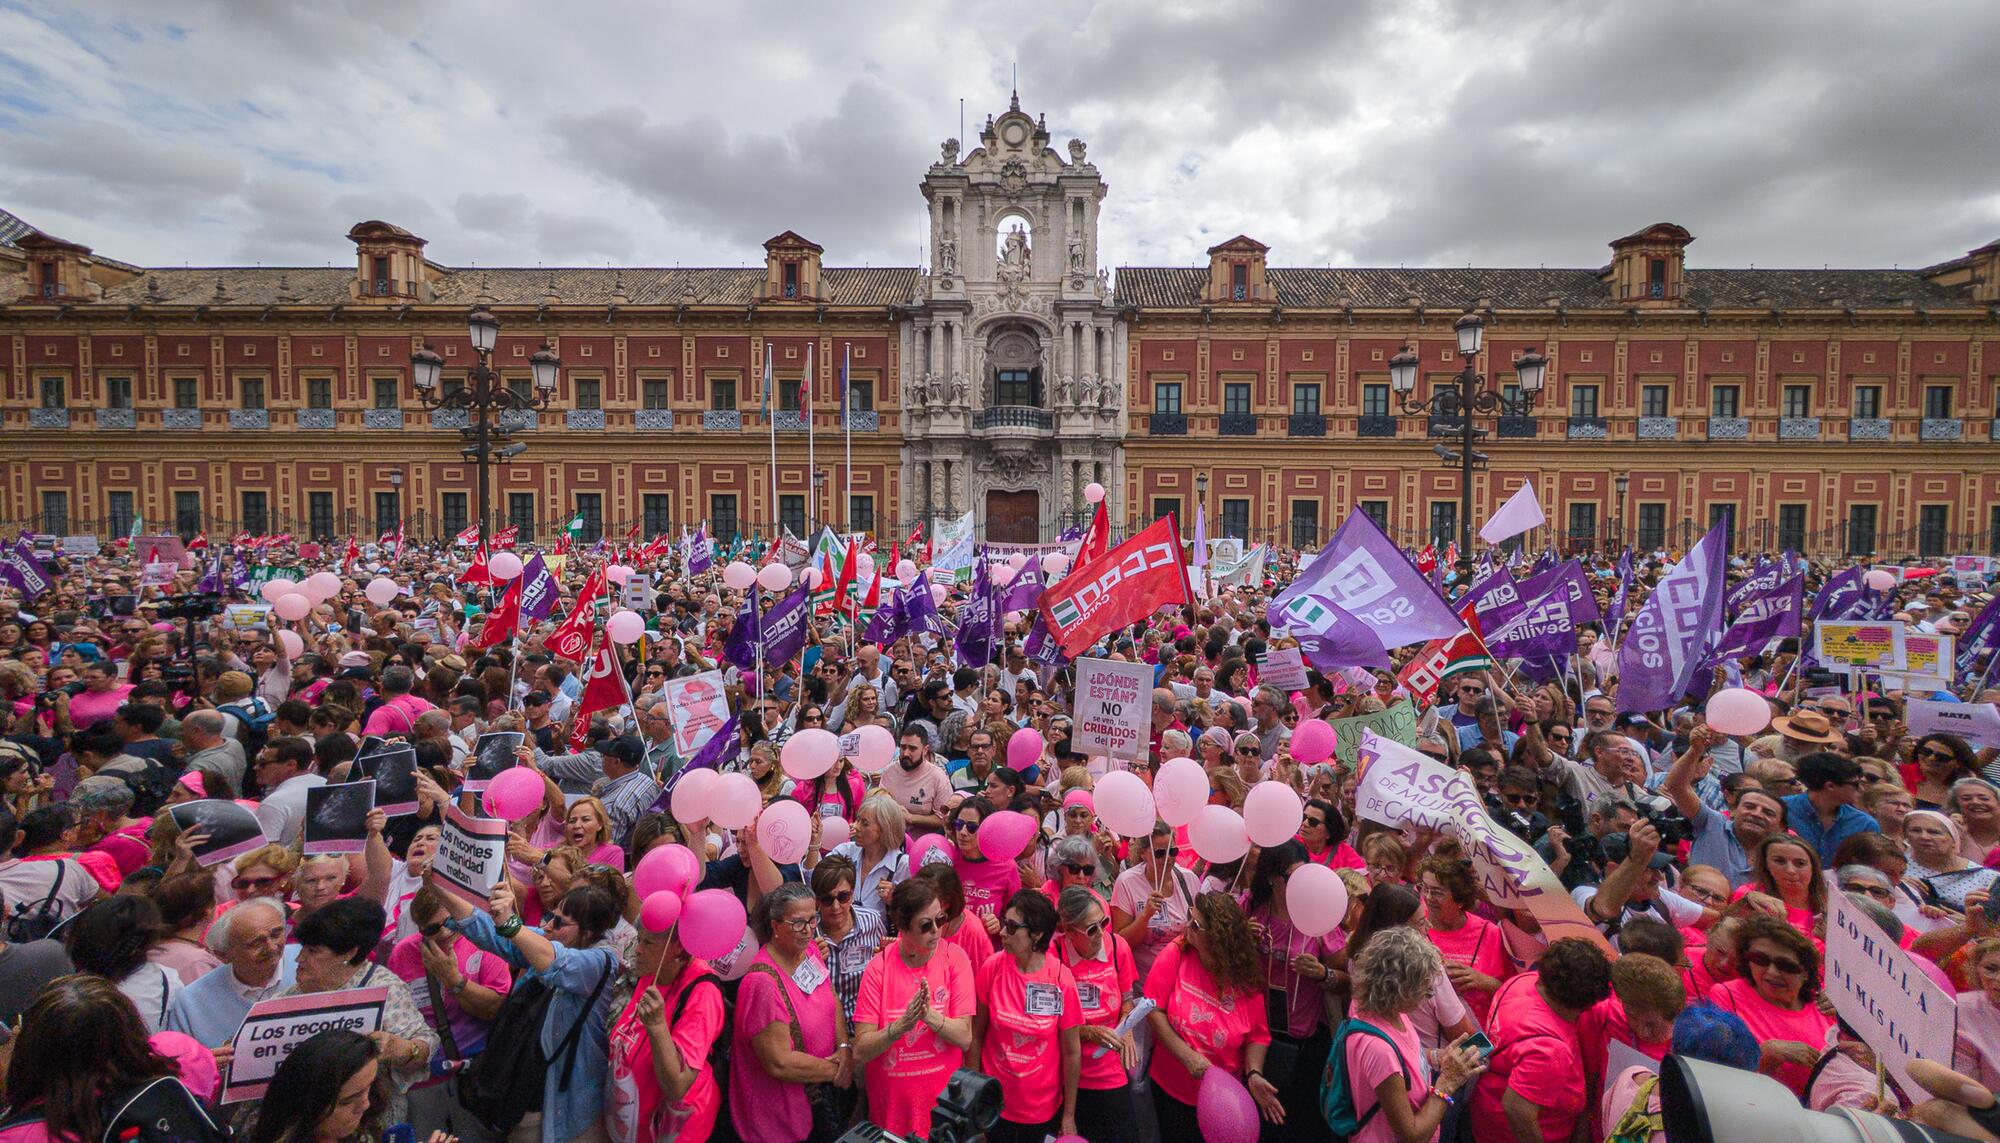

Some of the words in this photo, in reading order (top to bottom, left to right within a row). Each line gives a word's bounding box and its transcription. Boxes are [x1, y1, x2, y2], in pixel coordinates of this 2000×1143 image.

[1090, 672, 1139, 690] ¿DÓNDE
[1089, 686, 1137, 704] ESTÁN?
[1101, 702, 1122, 716] NO
[1083, 722, 1136, 739] CRIBADOS
[1102, 717, 1116, 726] ven,
[1118, 719, 1128, 727] los
[1095, 736, 1108, 746] del
[1110, 738, 1125, 748] PP
[1379, 776, 1398, 791] DE
[1366, 797, 1383, 812] DE
[441, 823, 453, 840] Los
[453, 837, 493, 860] recortes
[440, 844, 449, 857] en
[449, 848, 484, 875] sanidad
[446, 865, 473, 886] matan
[250, 1026, 285, 1041] Los
[289, 1016, 364, 1037] recortes
[253, 1044, 277, 1058] en
